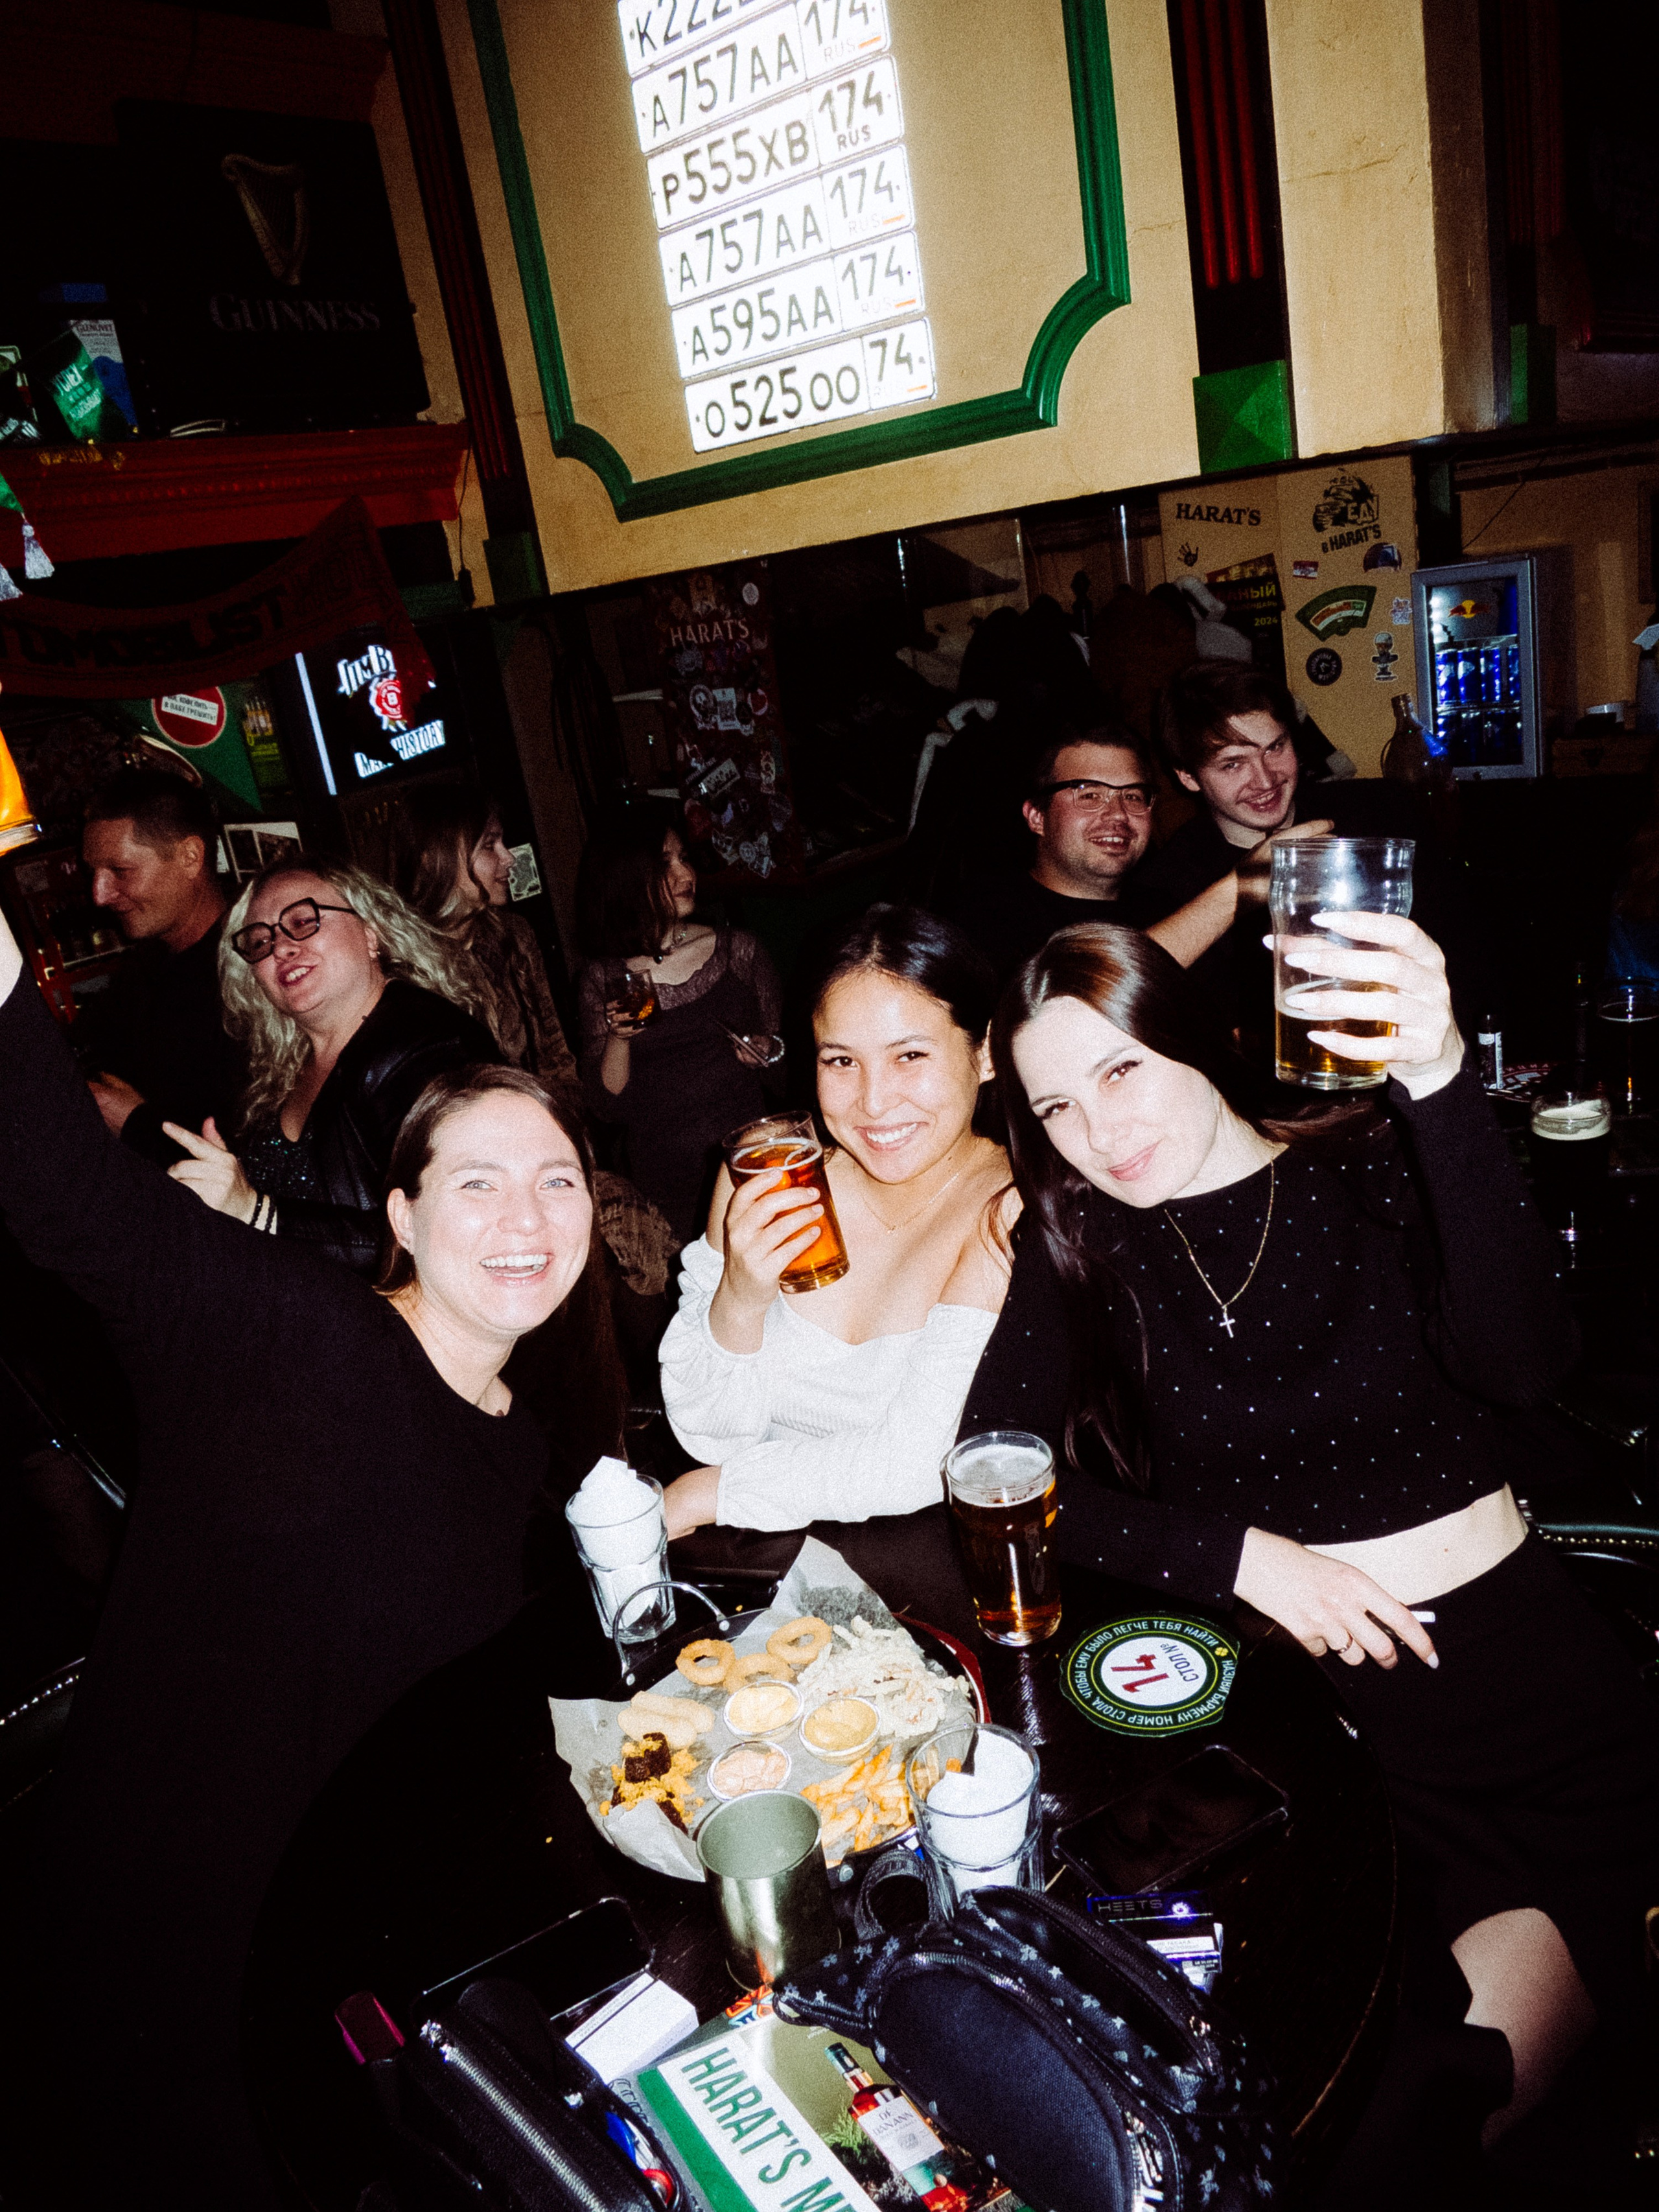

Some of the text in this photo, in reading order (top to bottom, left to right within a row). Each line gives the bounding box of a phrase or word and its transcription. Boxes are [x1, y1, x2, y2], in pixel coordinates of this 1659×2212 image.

[824, 39, 855, 61] RUS
[653, 0, 868, 137] A757AA 174
[661, 71, 883, 216] P555XB 174
[837, 124, 871, 151] RUS
[680, 161, 894, 292] A757AA 174
[848, 213, 881, 236] RUS
[208, 291, 381, 332] GUINNESS
[691, 246, 905, 365] A595AA 174
[869, 332, 913, 382] 74
[1176, 504, 1261, 526] HARAT'S
[1329, 524, 1382, 552] HARAT'S
[669, 618, 750, 647] HARAT'S
[1253, 616, 1279, 627] 2024
[390, 719, 446, 760] HISTORY
[1075, 1620, 1220, 1699] ЧТОБЫ ЕМУ БЫЛО ЛЕГЧЕ ТЕБЯ НАЙТИ
[1110, 1654, 1170, 1693] 14
[1168, 1653, 1199, 1682] СТОЛ
[1221, 1659, 1235, 1694] НАЗОВИ
[1127, 1715, 1174, 1726] НОМЕР
[1177, 1693, 1226, 1723] БАРМЕНУ
[1098, 1899, 1163, 1912] HEETS
[681, 2047, 812, 2184] HARAT'S
